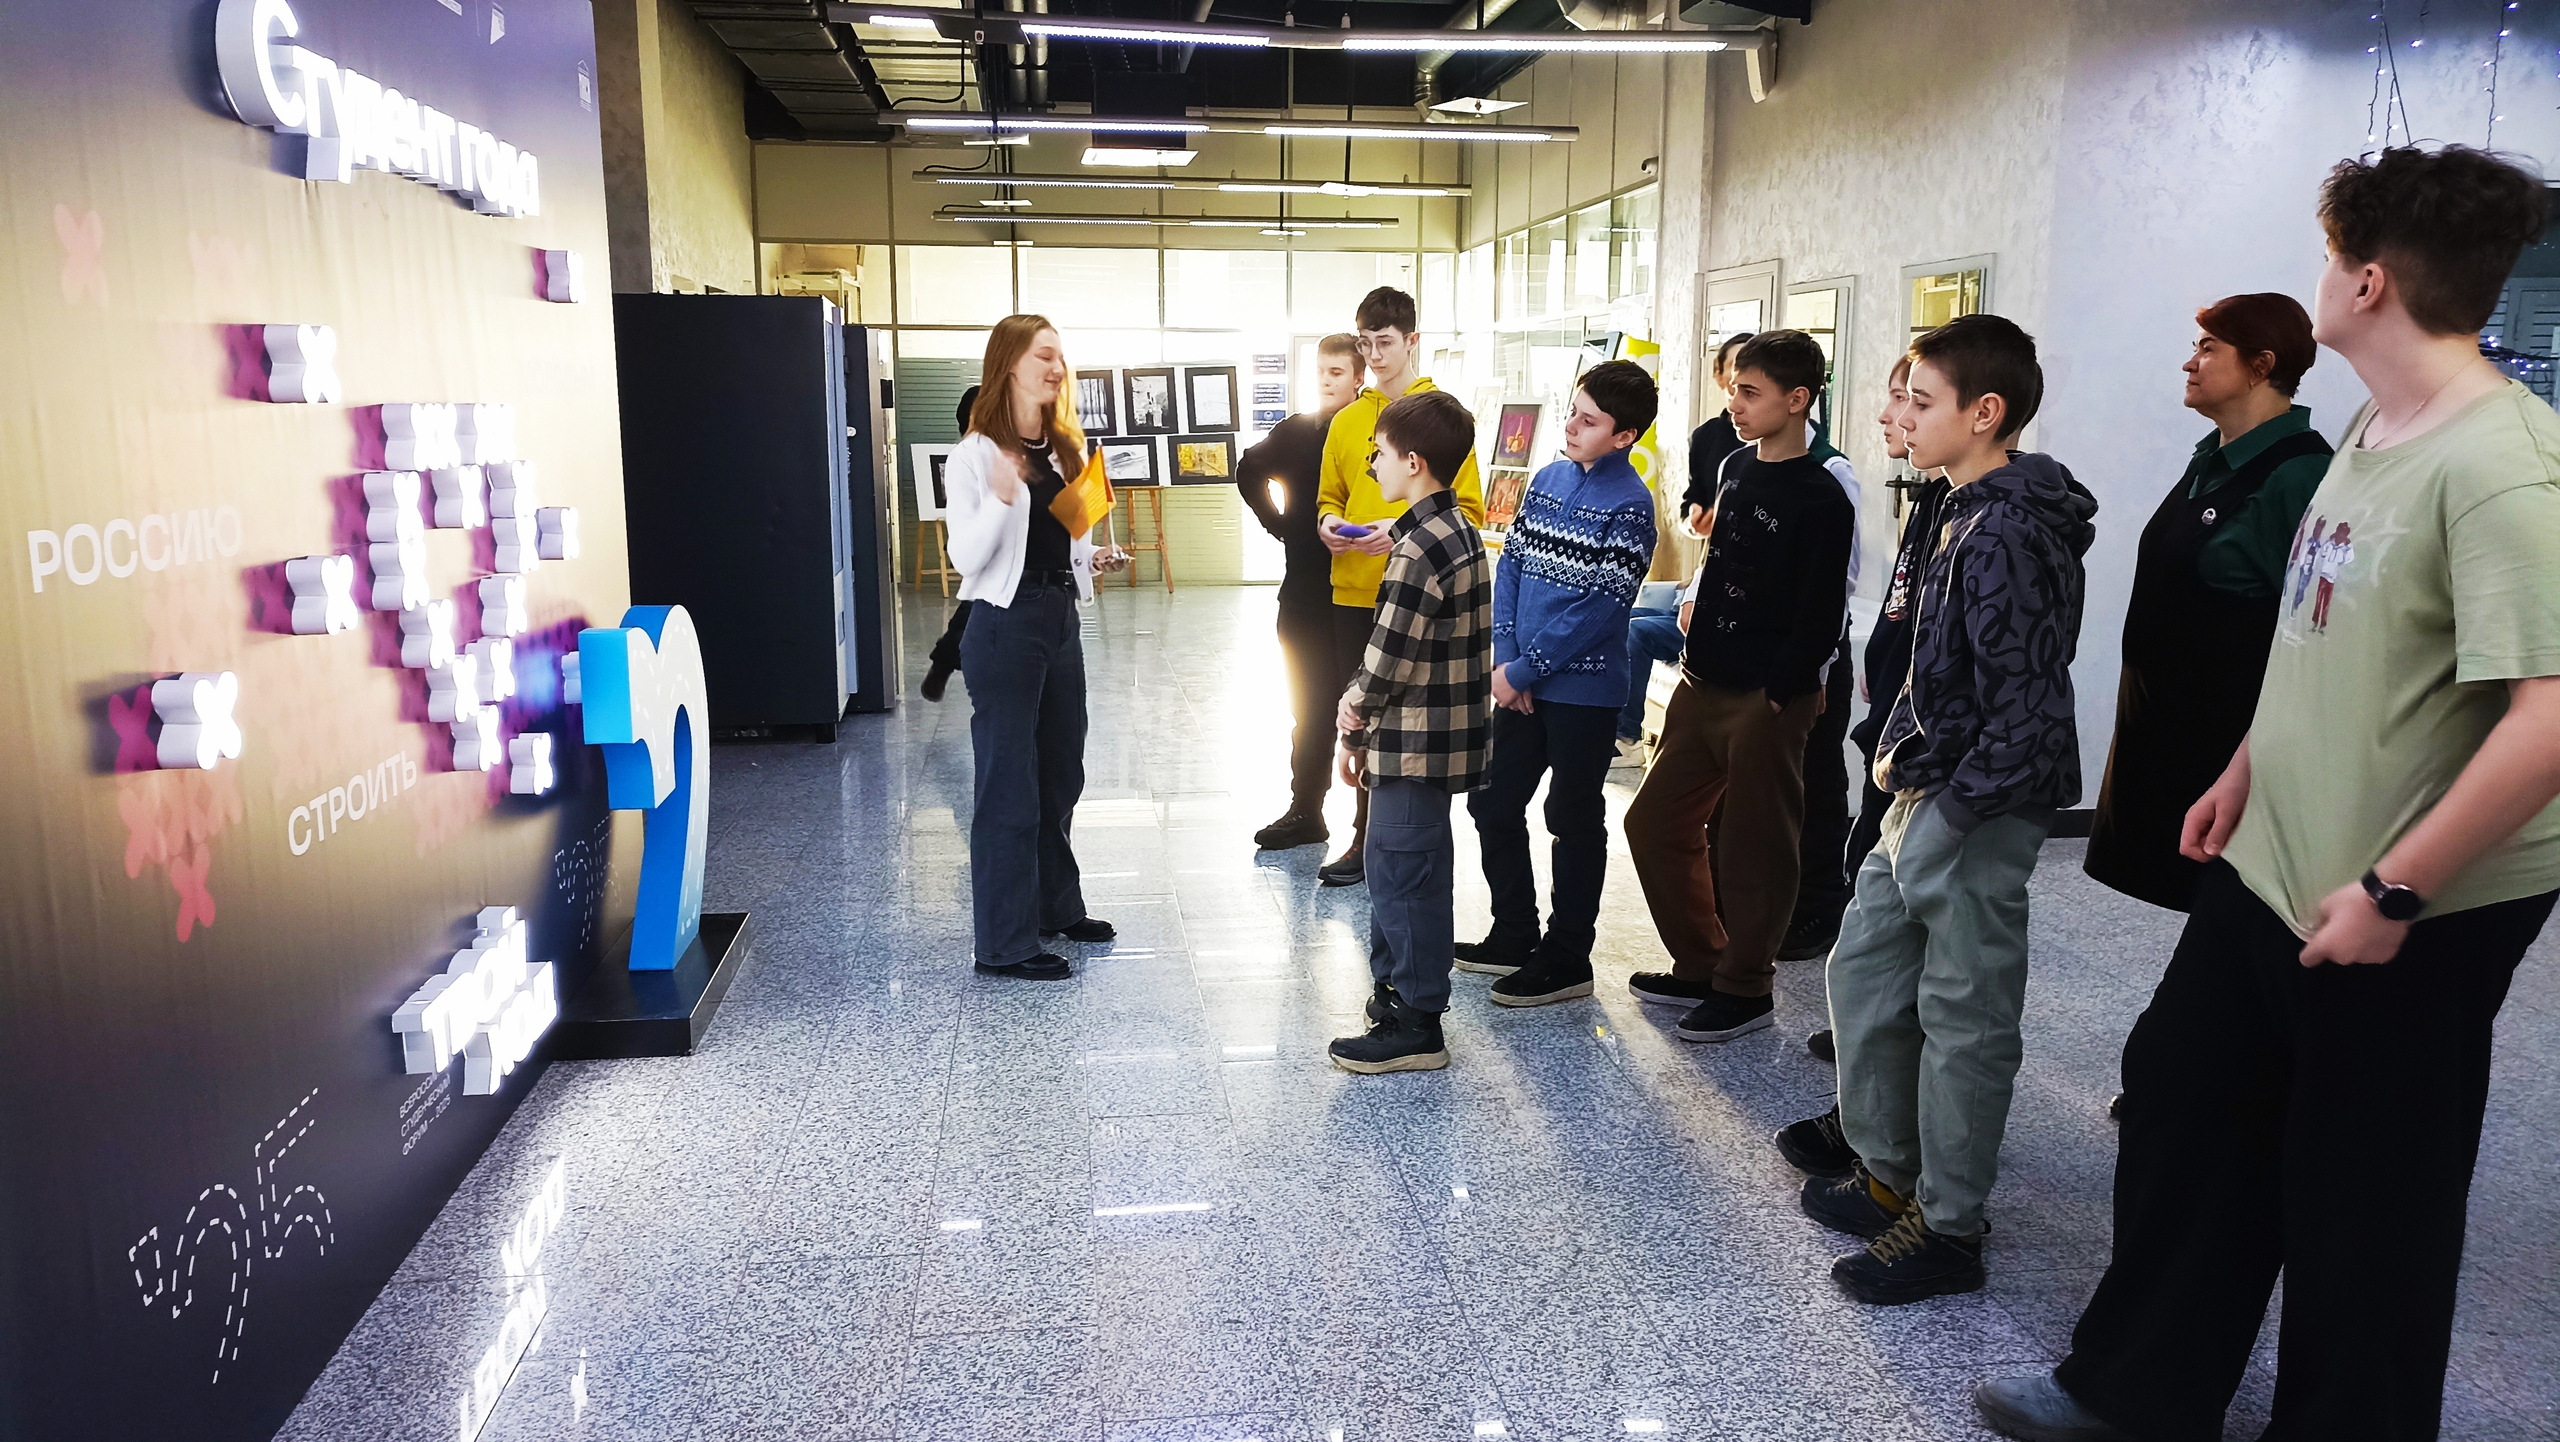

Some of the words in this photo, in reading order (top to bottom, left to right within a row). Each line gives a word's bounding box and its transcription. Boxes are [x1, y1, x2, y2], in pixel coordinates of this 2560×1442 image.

[27, 505, 242, 594] РОССИЮ
[1753, 504, 1780, 533] YOUR
[288, 750, 417, 856] СТРОИТЬ
